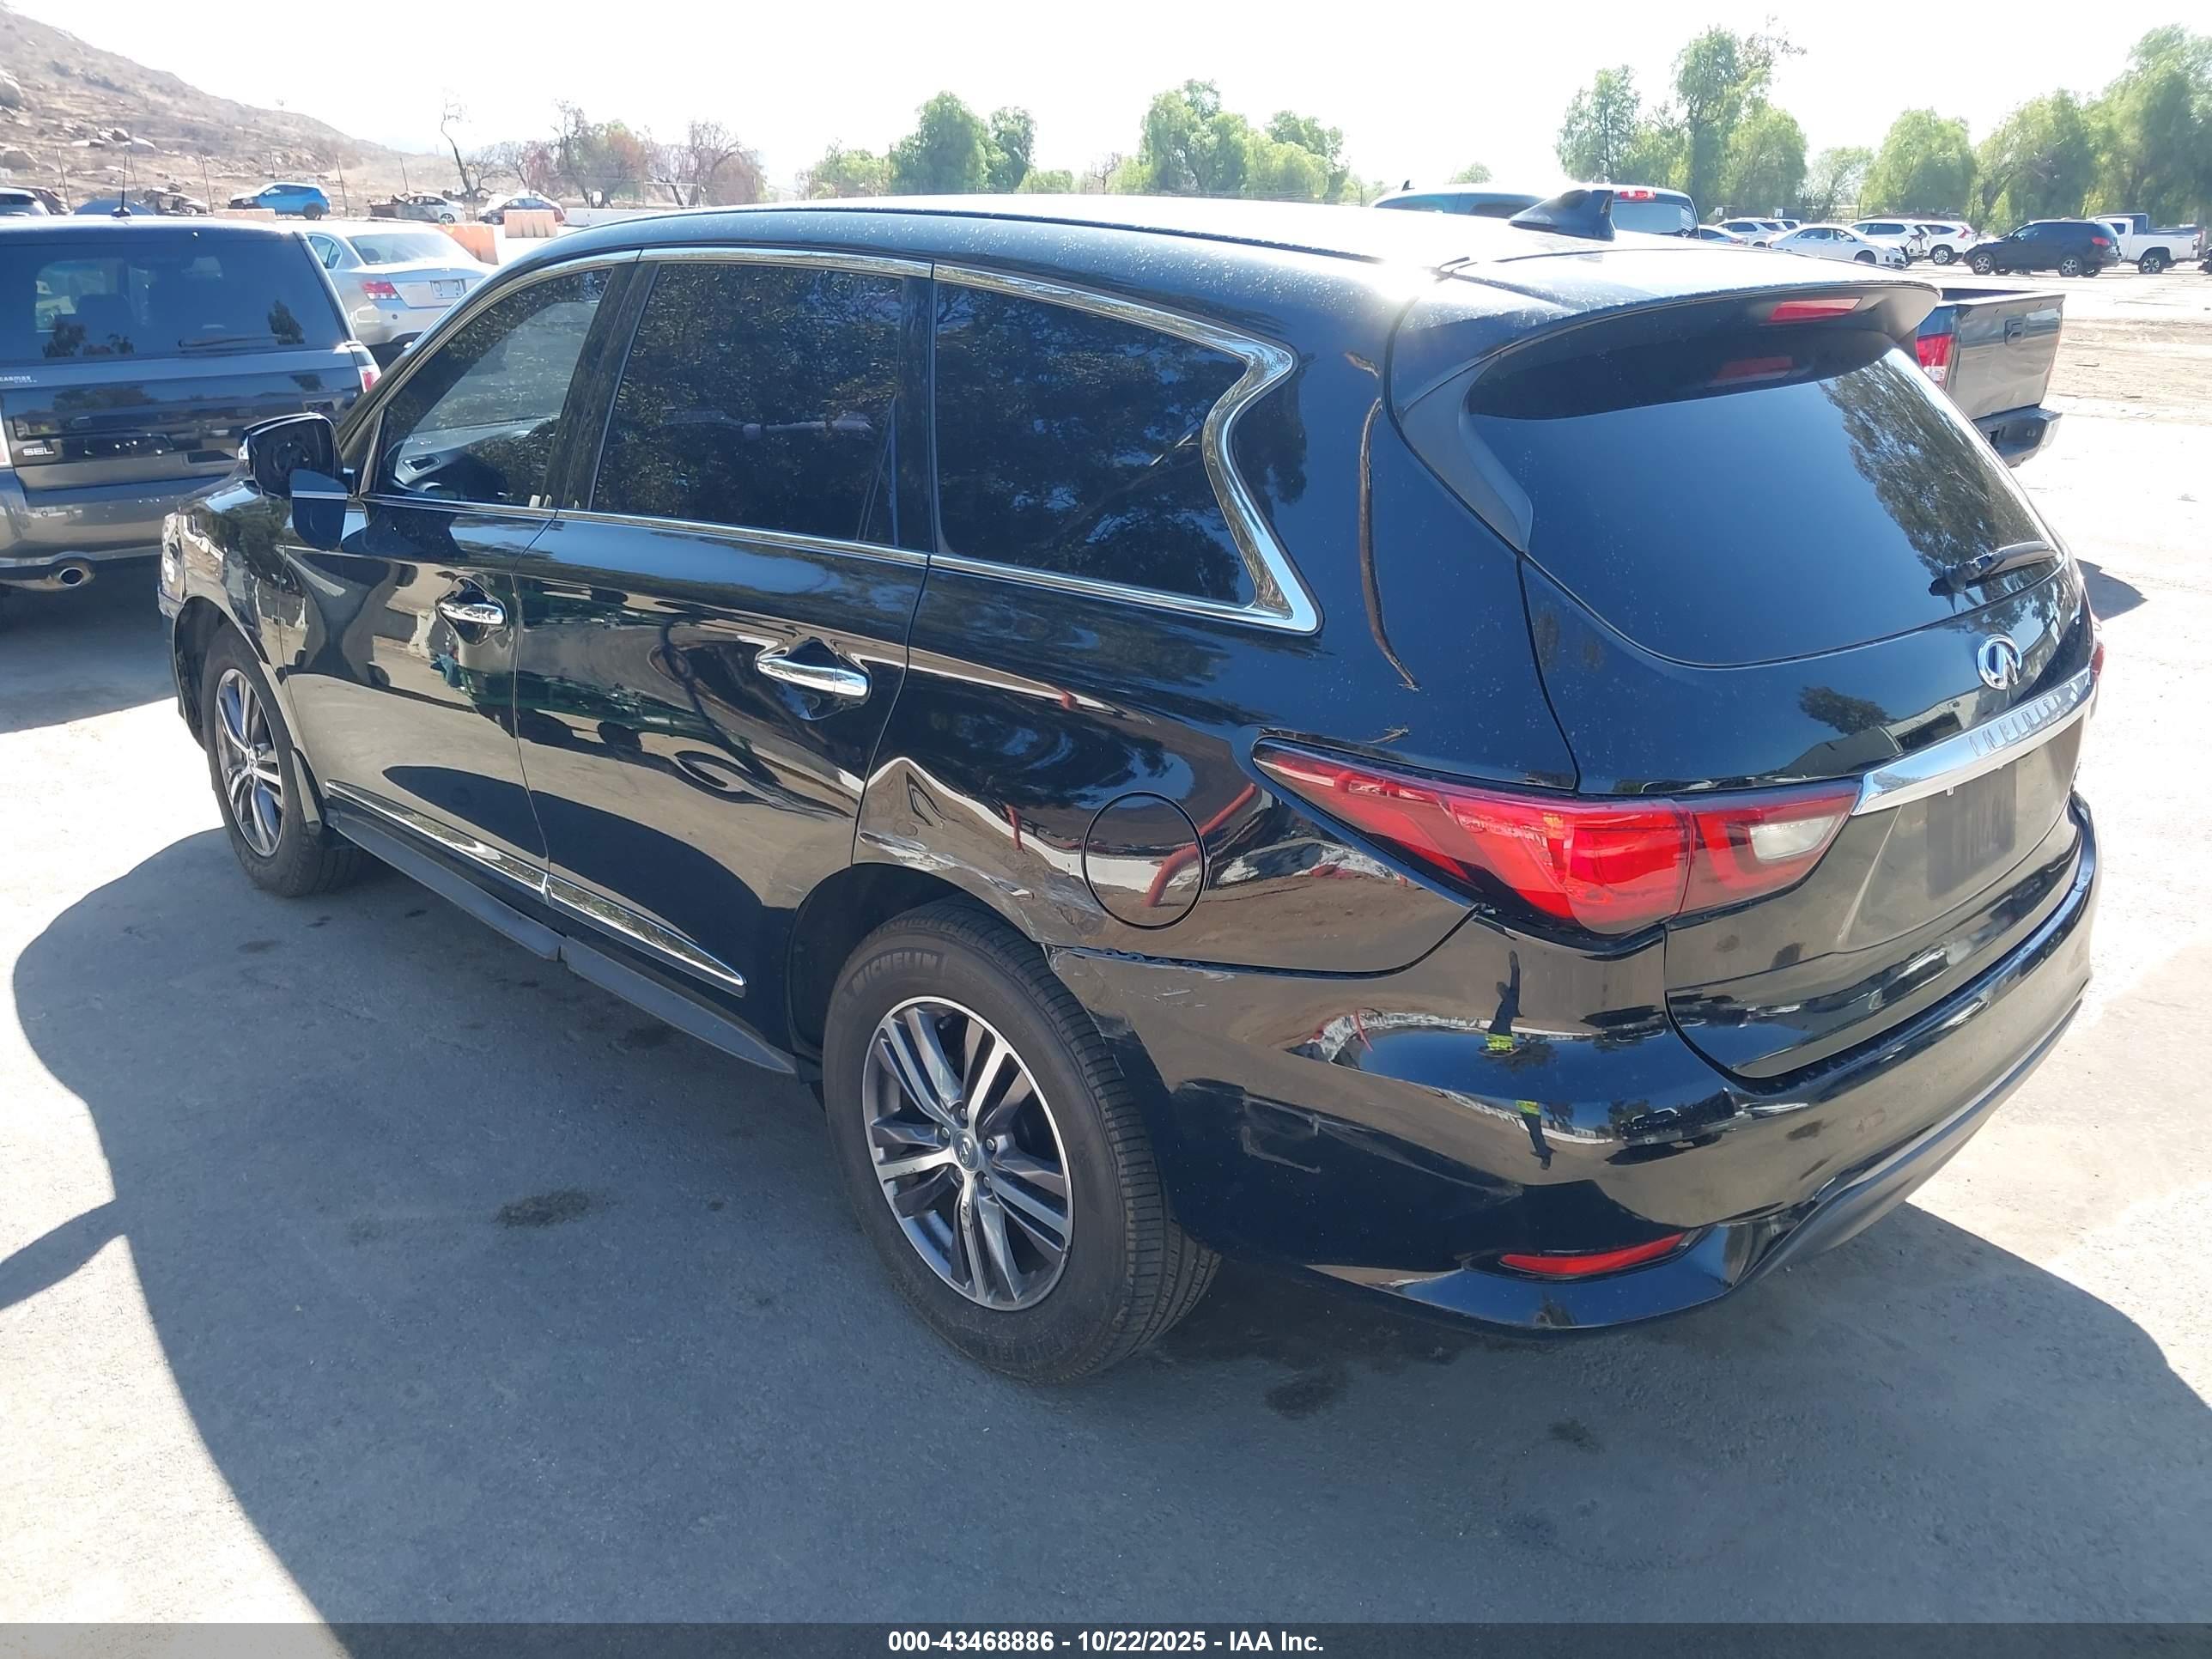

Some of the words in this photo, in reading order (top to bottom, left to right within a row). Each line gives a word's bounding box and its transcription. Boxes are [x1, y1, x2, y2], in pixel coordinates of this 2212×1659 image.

[22, 447, 54, 456] SEL
[1968, 695, 2062, 757] INFINITI
[851, 951, 938, 996] MICHELIN
